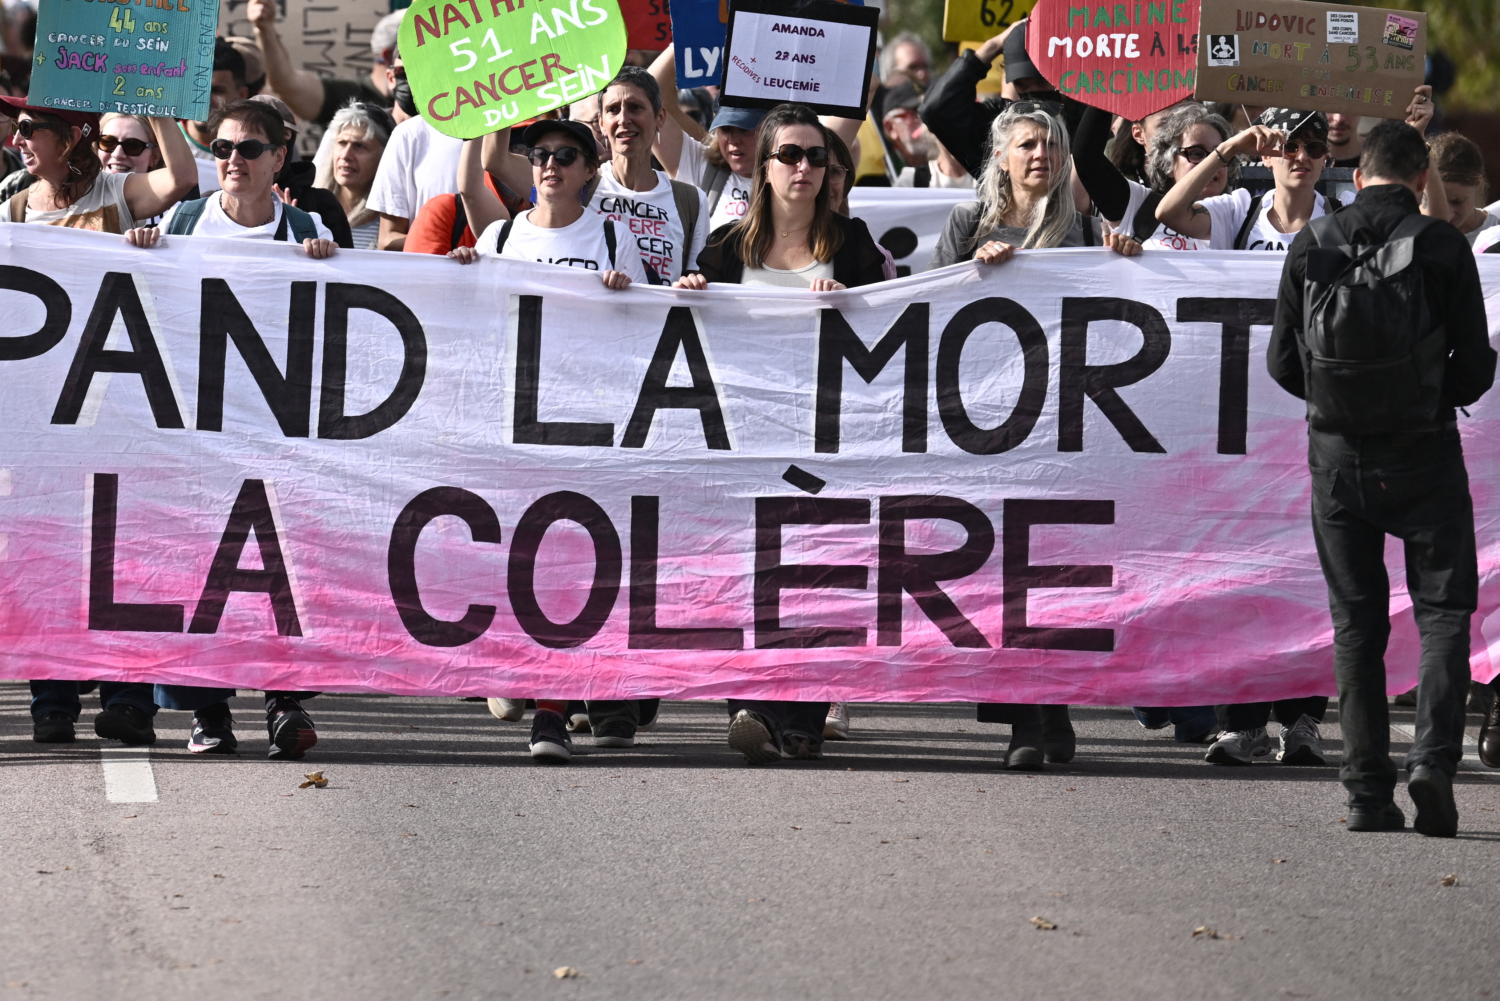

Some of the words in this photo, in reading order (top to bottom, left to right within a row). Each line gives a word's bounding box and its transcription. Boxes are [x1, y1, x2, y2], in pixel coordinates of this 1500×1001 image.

[108, 6, 136, 34] 44
[143, 21, 168, 34] ans
[771, 22, 826, 39] AMANDA
[1236, 9, 1316, 36] LUDOVIC
[48, 32, 106, 47] CANCER
[113, 37, 130, 48] DU
[135, 37, 170, 52] SEIN
[449, 27, 513, 72] 51
[1048, 33, 1141, 59] MORTE
[1150, 31, 1165, 57] À
[1252, 40, 1310, 61] MORT
[1319, 44, 1331, 65] À
[1346, 45, 1379, 72] 53
[1384, 54, 1415, 72] ANS
[55, 46, 108, 73] JACK
[112, 63, 136, 74] son
[140, 58, 188, 77] enfant
[684, 46, 725, 79] LY
[791, 53, 816, 64] ANS
[112, 75, 126, 96] 2
[136, 86, 164, 99] ans
[192, 65, 210, 105] NON
[427, 52, 576, 121] CANCER
[483, 101, 519, 127] DU
[537, 54, 611, 112] SEIN
[763, 77, 821, 92] LEUCEMIE
[1227, 73, 1284, 93] CANCER
[44, 96, 93, 109] CANCER
[99, 101, 112, 111] DU
[115, 101, 178, 116] TESTICULE
[600, 197, 669, 222] CANCER
[512, 295, 731, 450] LA
[814, 296, 1276, 455] MORT
[89, 473, 303, 637] LA
[387, 464, 1115, 652] COLÈRE
